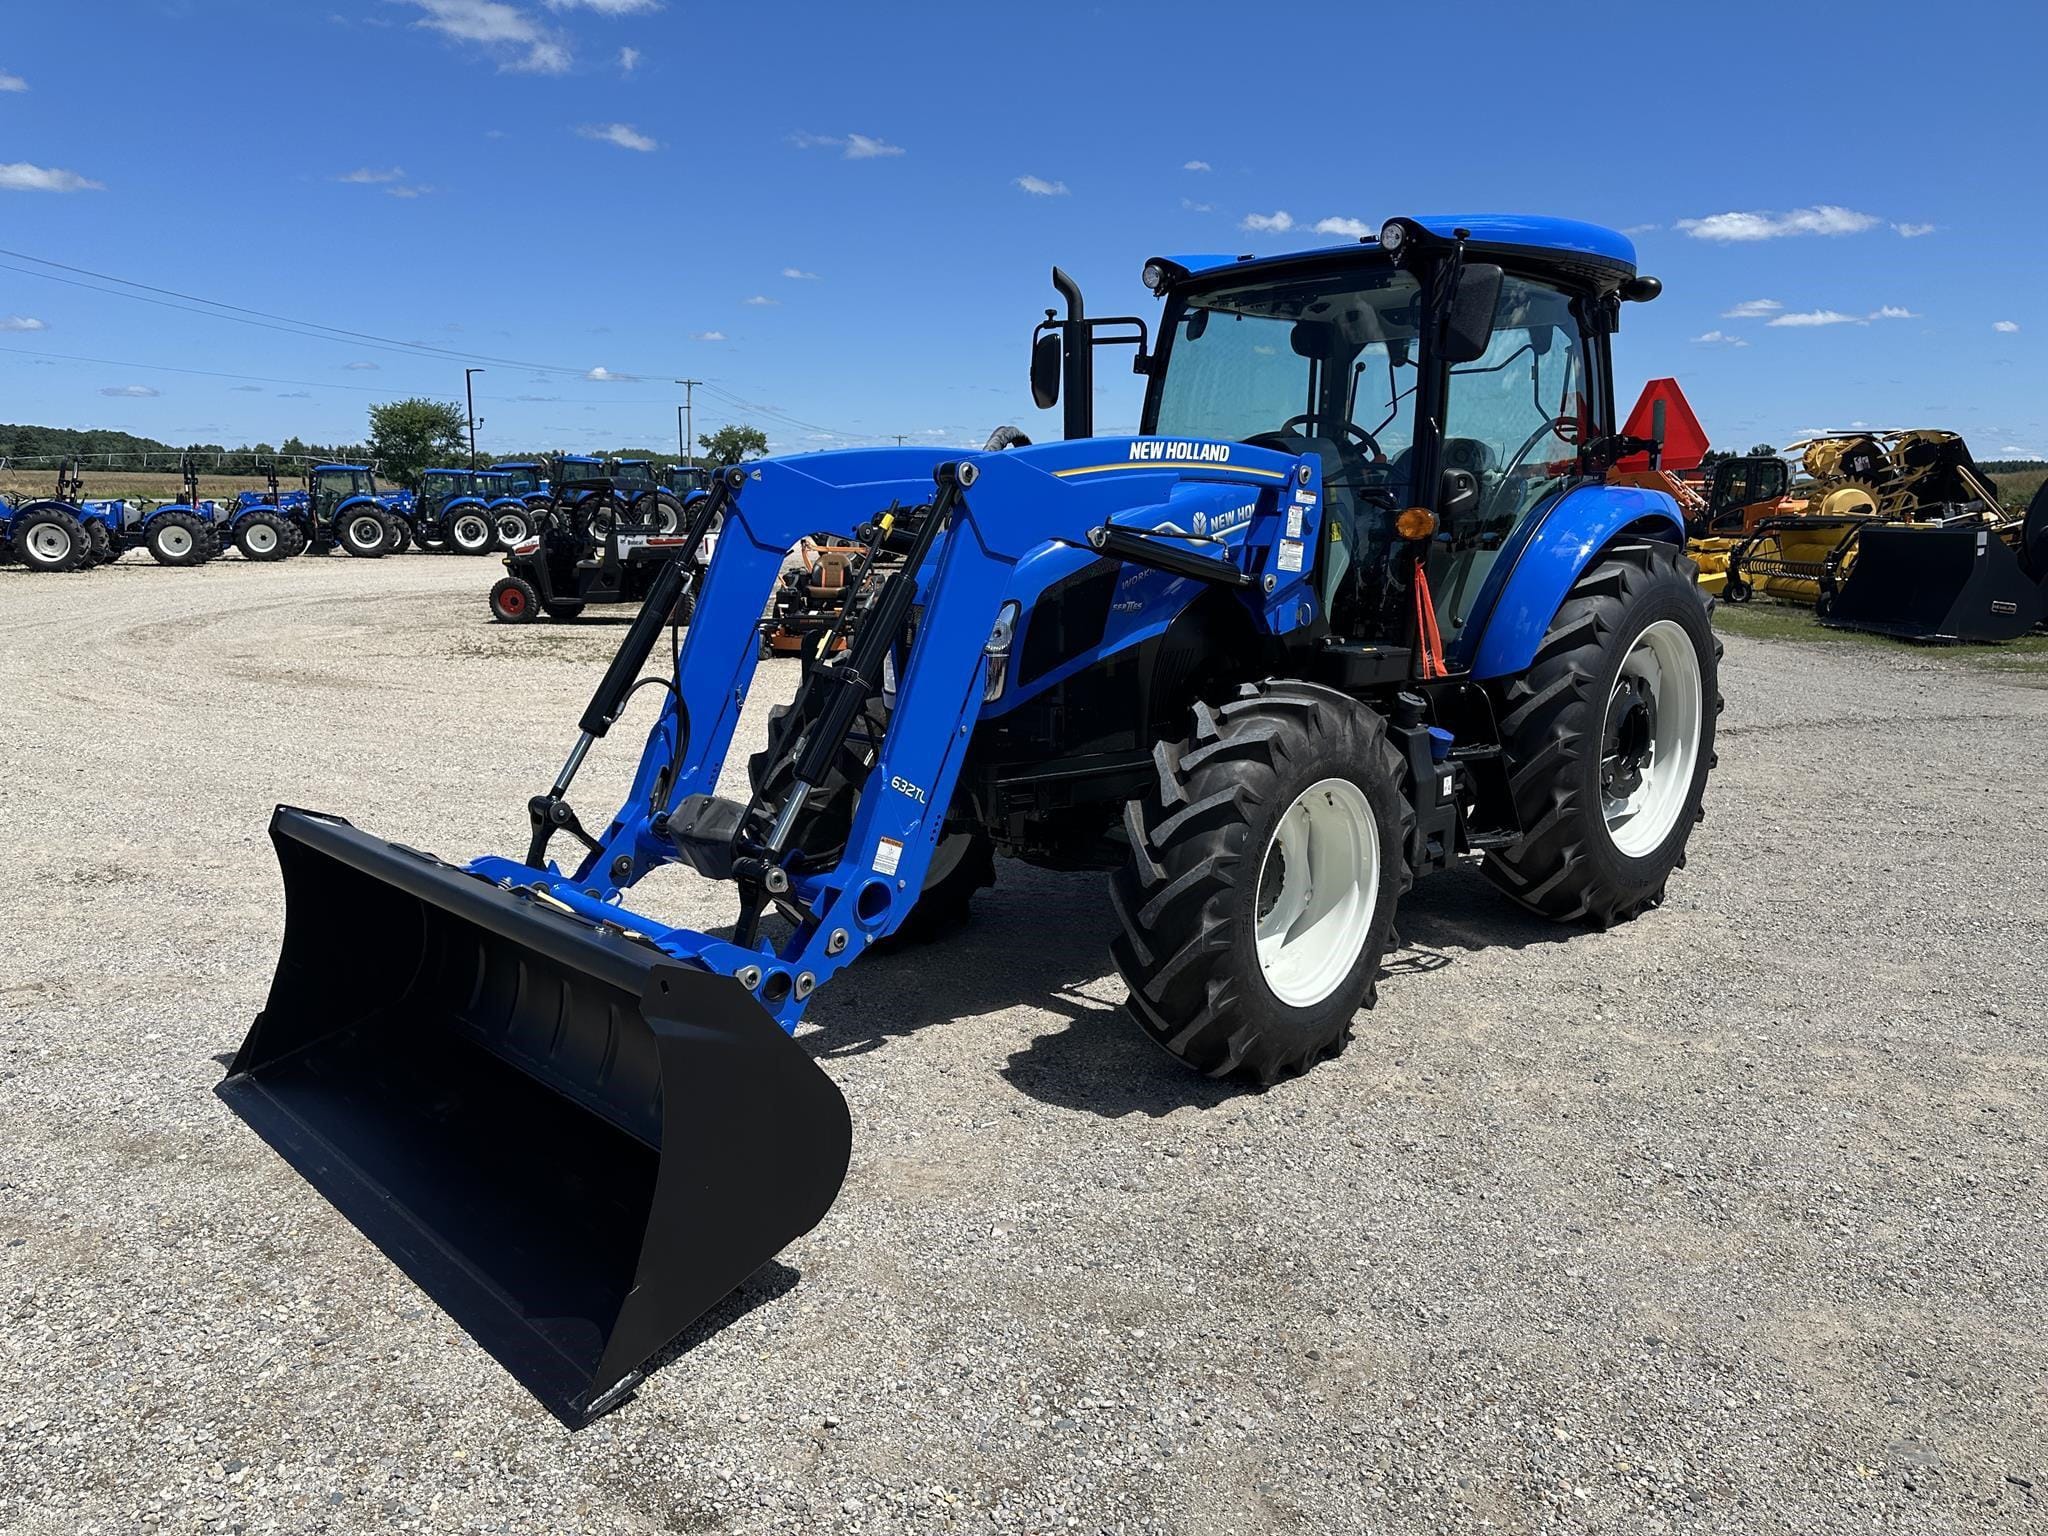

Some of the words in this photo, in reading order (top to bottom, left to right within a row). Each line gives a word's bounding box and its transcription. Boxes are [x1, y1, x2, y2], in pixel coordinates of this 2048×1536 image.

[1129, 441, 1165, 460] NEW
[1165, 441, 1230, 462] HOLLAND
[1210, 509, 1235, 532] NEW
[891, 775, 926, 804] 632TL
